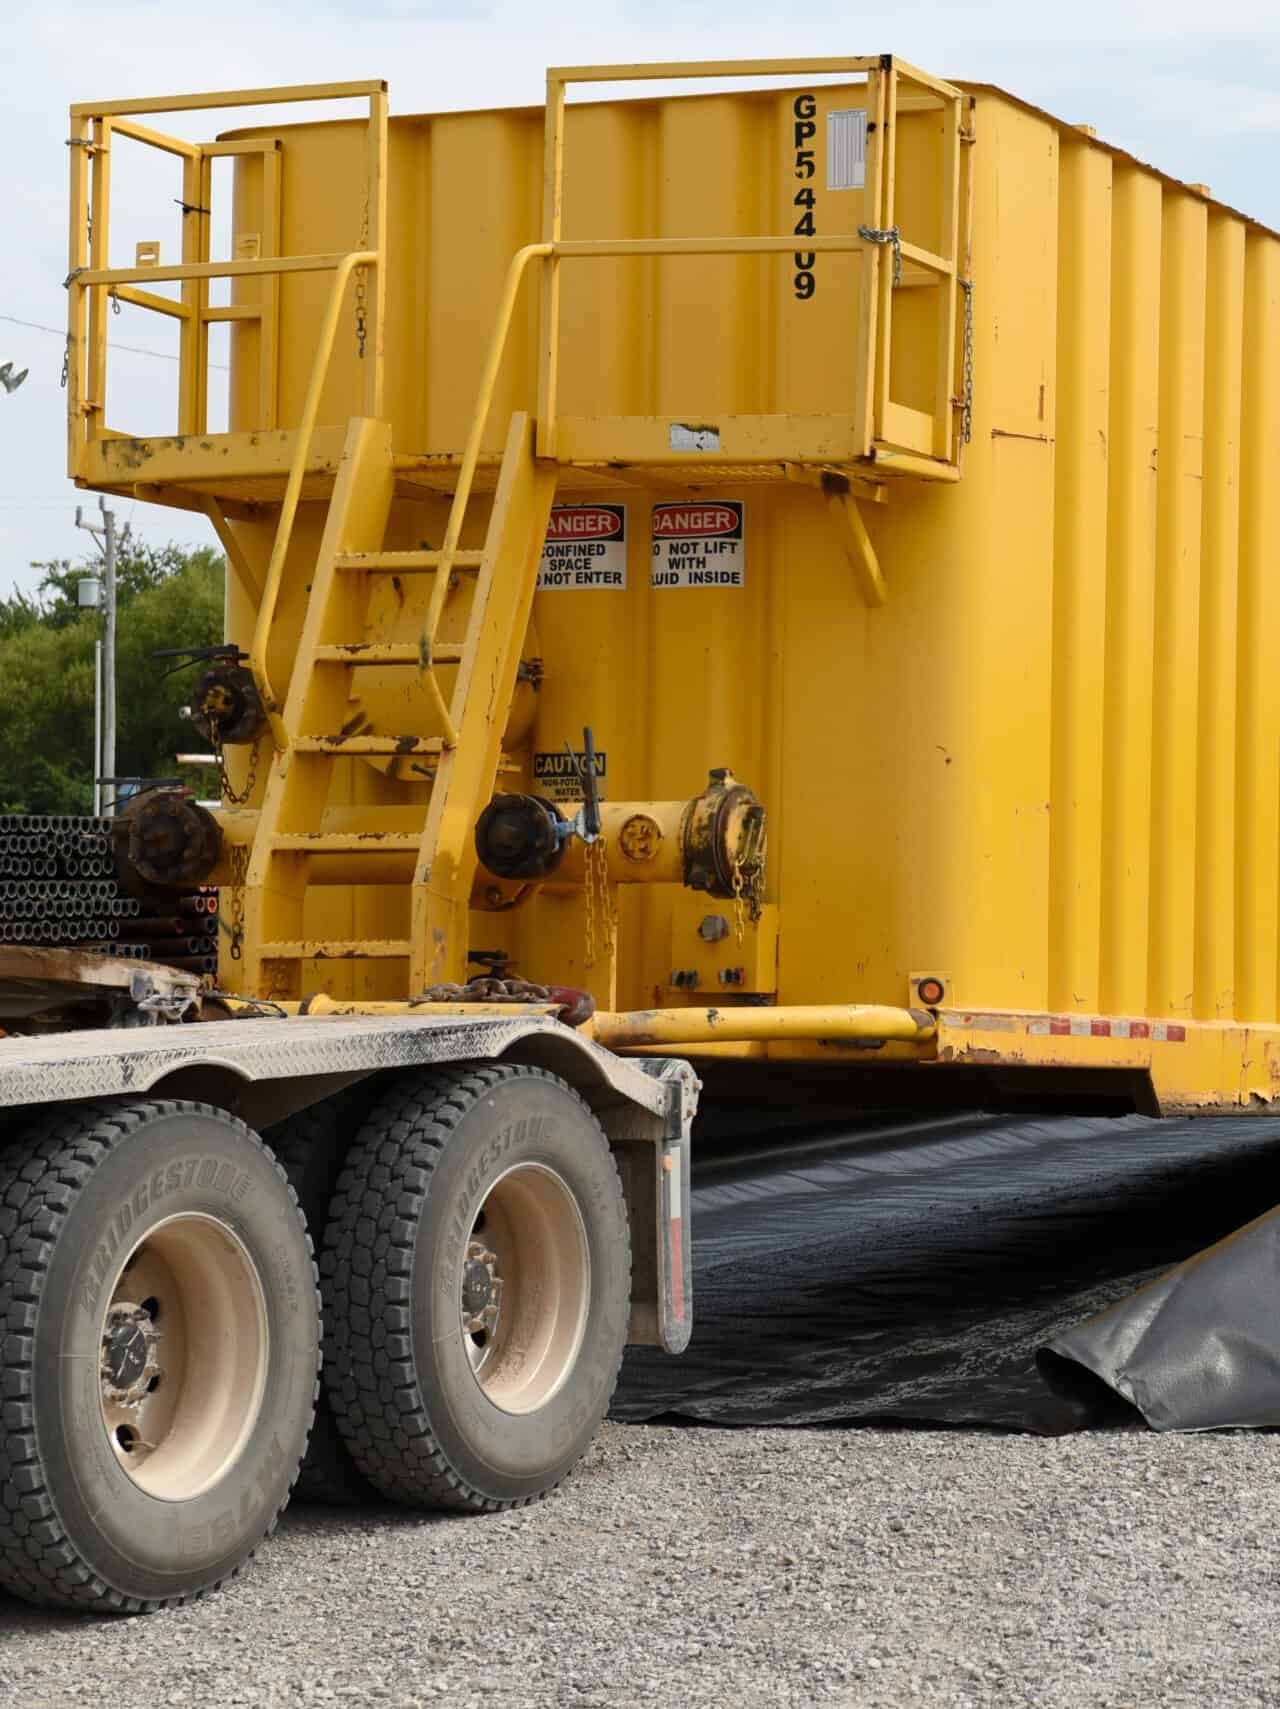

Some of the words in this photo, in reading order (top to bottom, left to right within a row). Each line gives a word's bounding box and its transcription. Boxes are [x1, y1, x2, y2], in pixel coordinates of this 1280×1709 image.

[547, 514, 613, 534] ANGER
[542, 544, 606, 558] ONFINED
[669, 542, 699, 555] NOT
[704, 541, 738, 554] LIFT
[549, 558, 592, 571] SPACE
[668, 557, 706, 570] WITH
[544, 572, 571, 585] NOT
[576, 571, 622, 585] ENTER
[652, 572, 679, 585] UID
[688, 571, 740, 585] INSIDE
